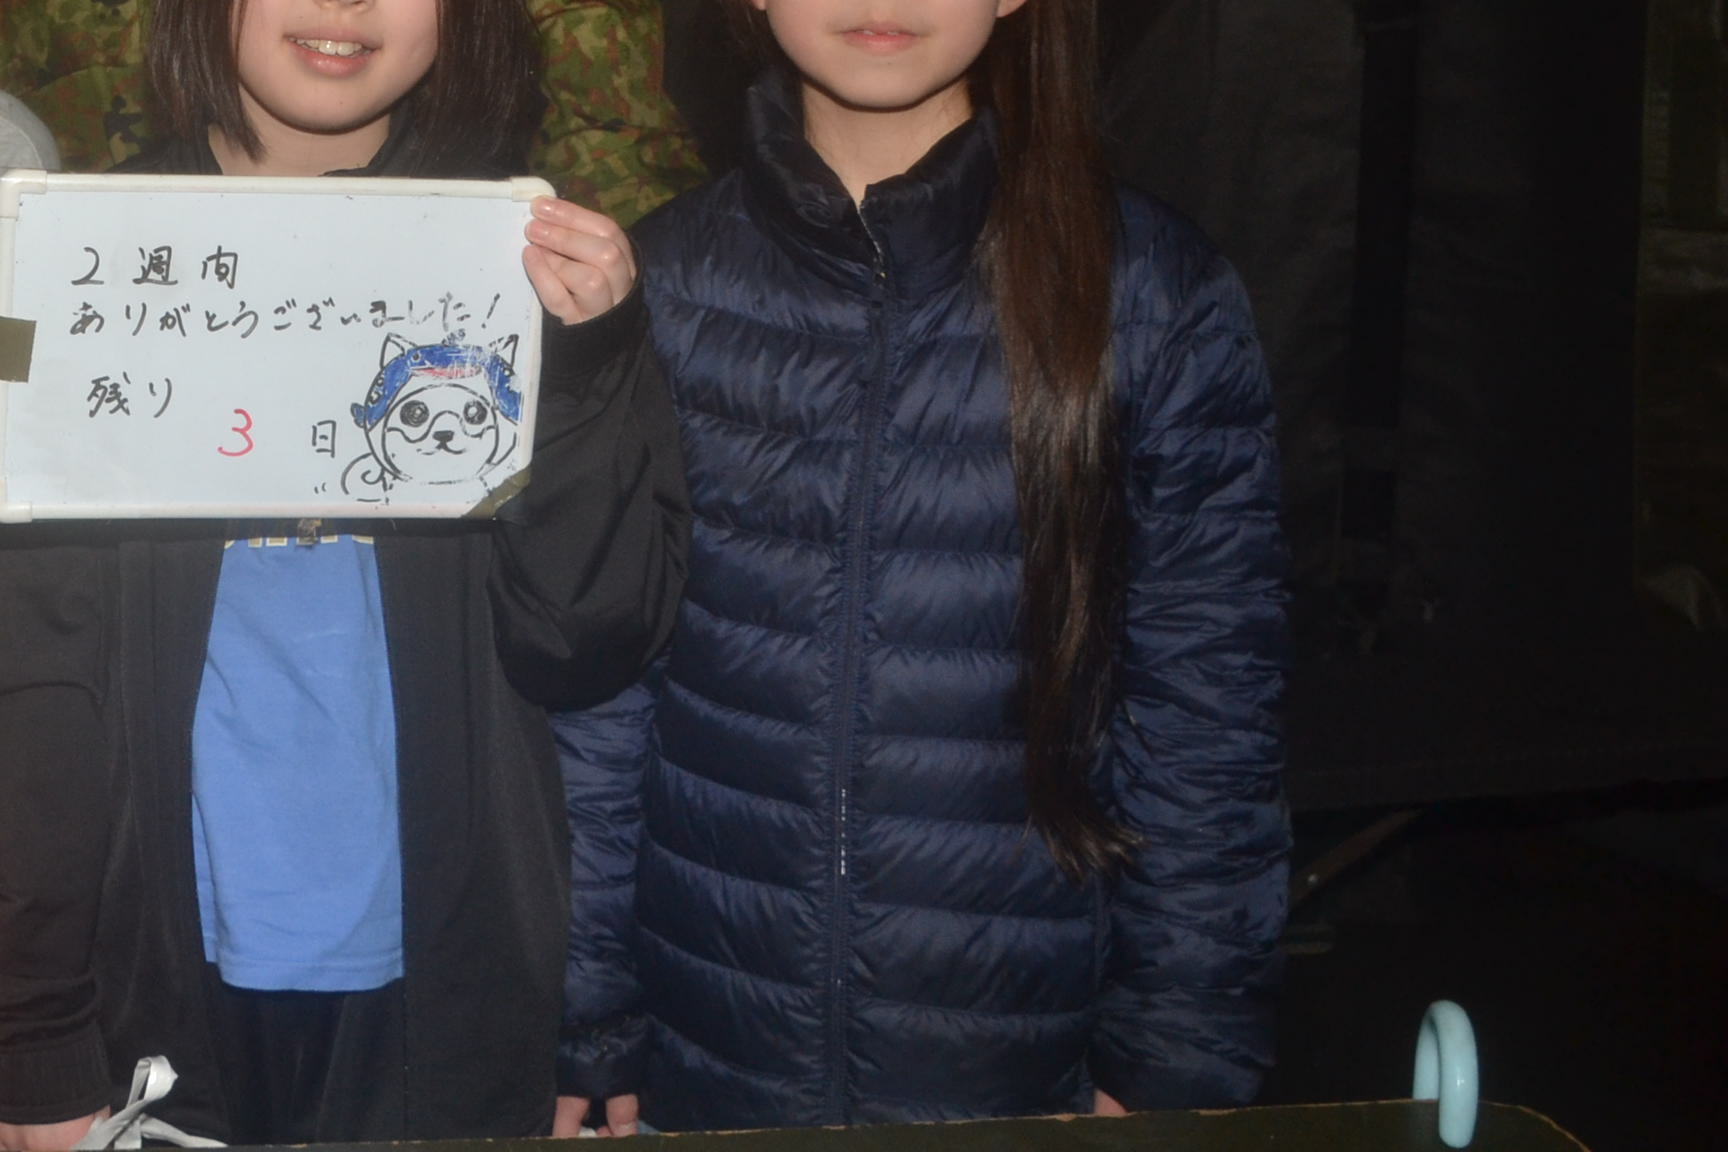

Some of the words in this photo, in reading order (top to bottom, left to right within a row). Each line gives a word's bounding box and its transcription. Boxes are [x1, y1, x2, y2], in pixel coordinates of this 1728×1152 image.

[86, 371, 174, 418] 残り
[216, 407, 255, 457] 3
[311, 419, 337, 459] 日
